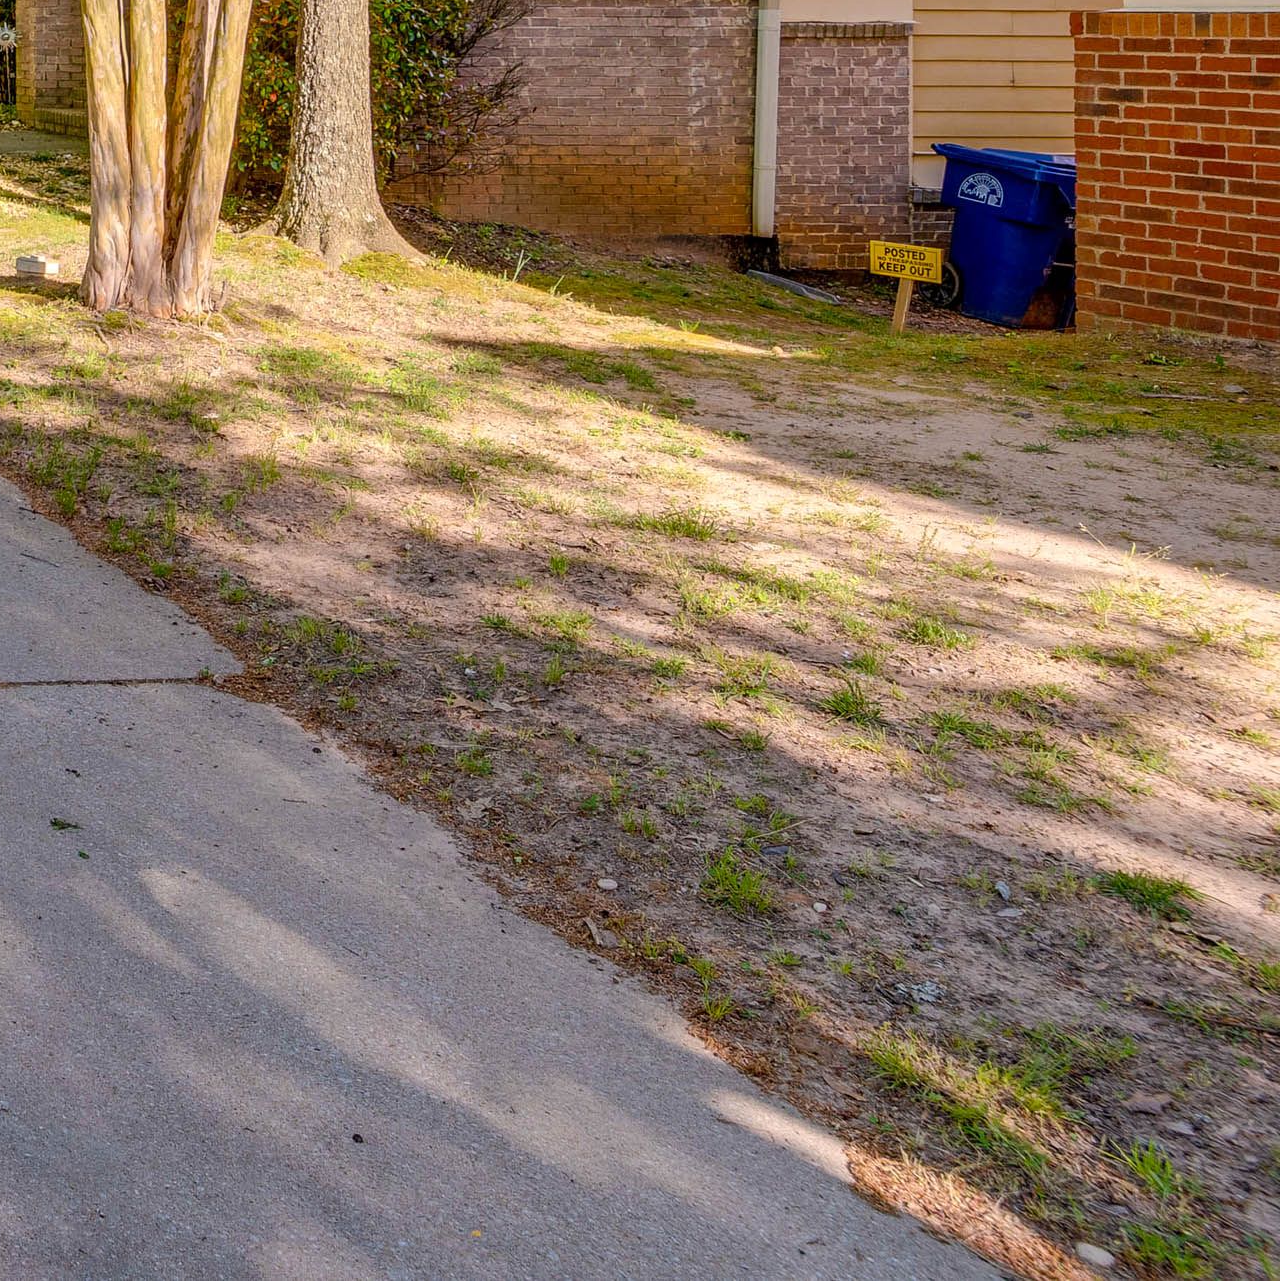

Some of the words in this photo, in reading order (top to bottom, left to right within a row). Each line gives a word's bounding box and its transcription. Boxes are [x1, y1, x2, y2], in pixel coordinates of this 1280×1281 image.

[884, 247, 926, 261] POSTED
[879, 261, 906, 273] KEEP
[909, 266, 932, 278] OUT
[889, 257, 934, 268] TRESPASSING
